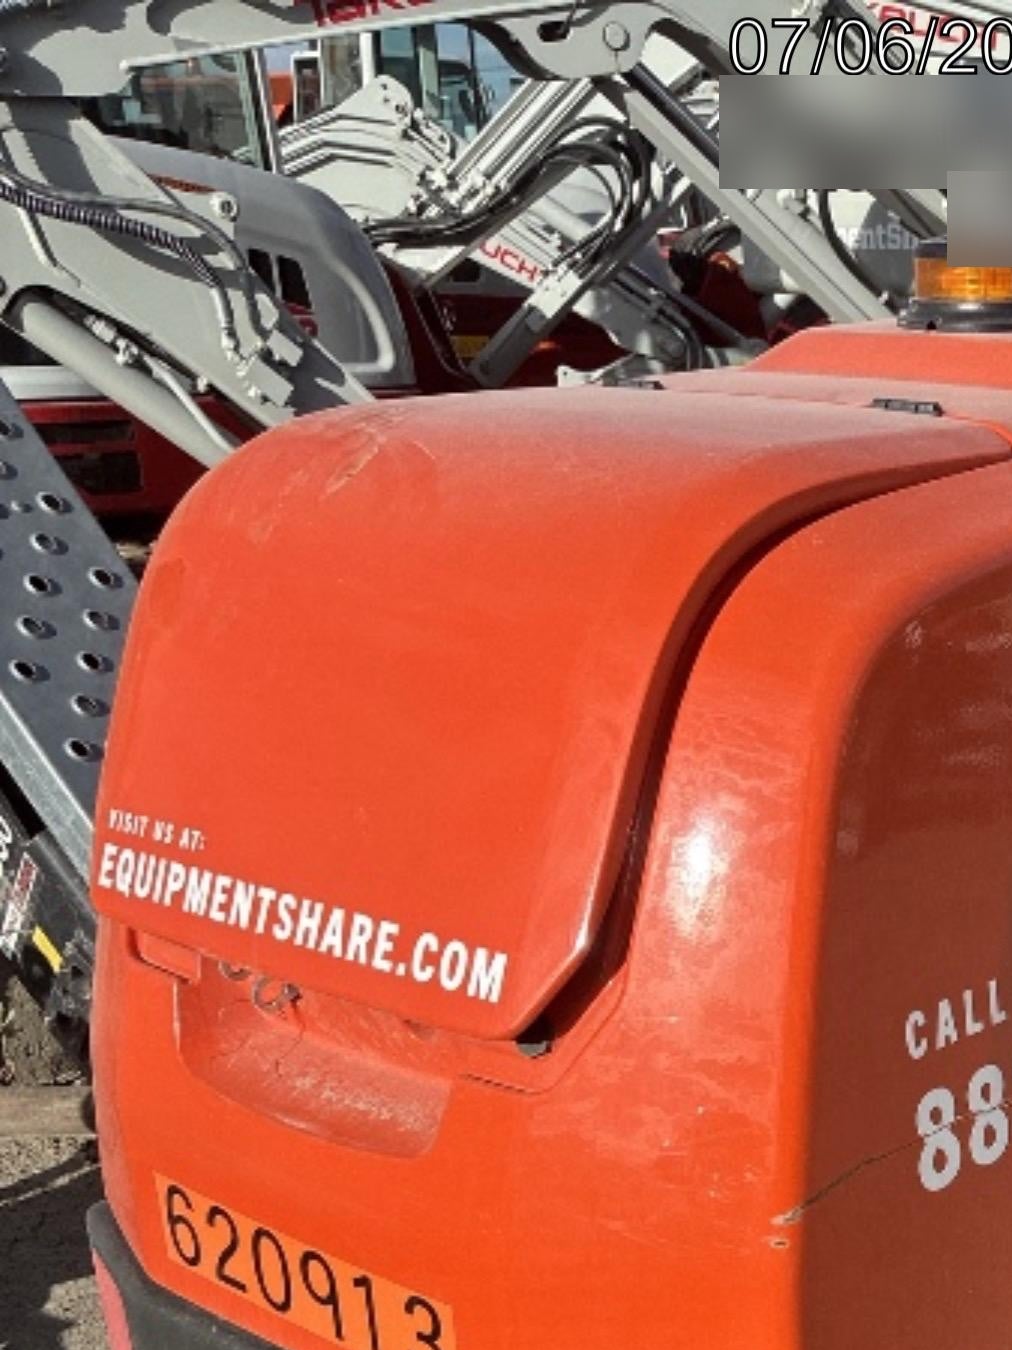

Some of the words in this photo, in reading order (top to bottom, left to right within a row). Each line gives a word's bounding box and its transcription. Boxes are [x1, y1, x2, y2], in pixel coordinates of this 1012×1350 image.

[109, 808, 149, 838] VISIT
[153, 819, 175, 845] US
[179, 827, 205, 853] AT:
[98, 842, 508, 1004] EQUIPMENTSHARE.COM
[904, 978, 1006, 1060] CALL
